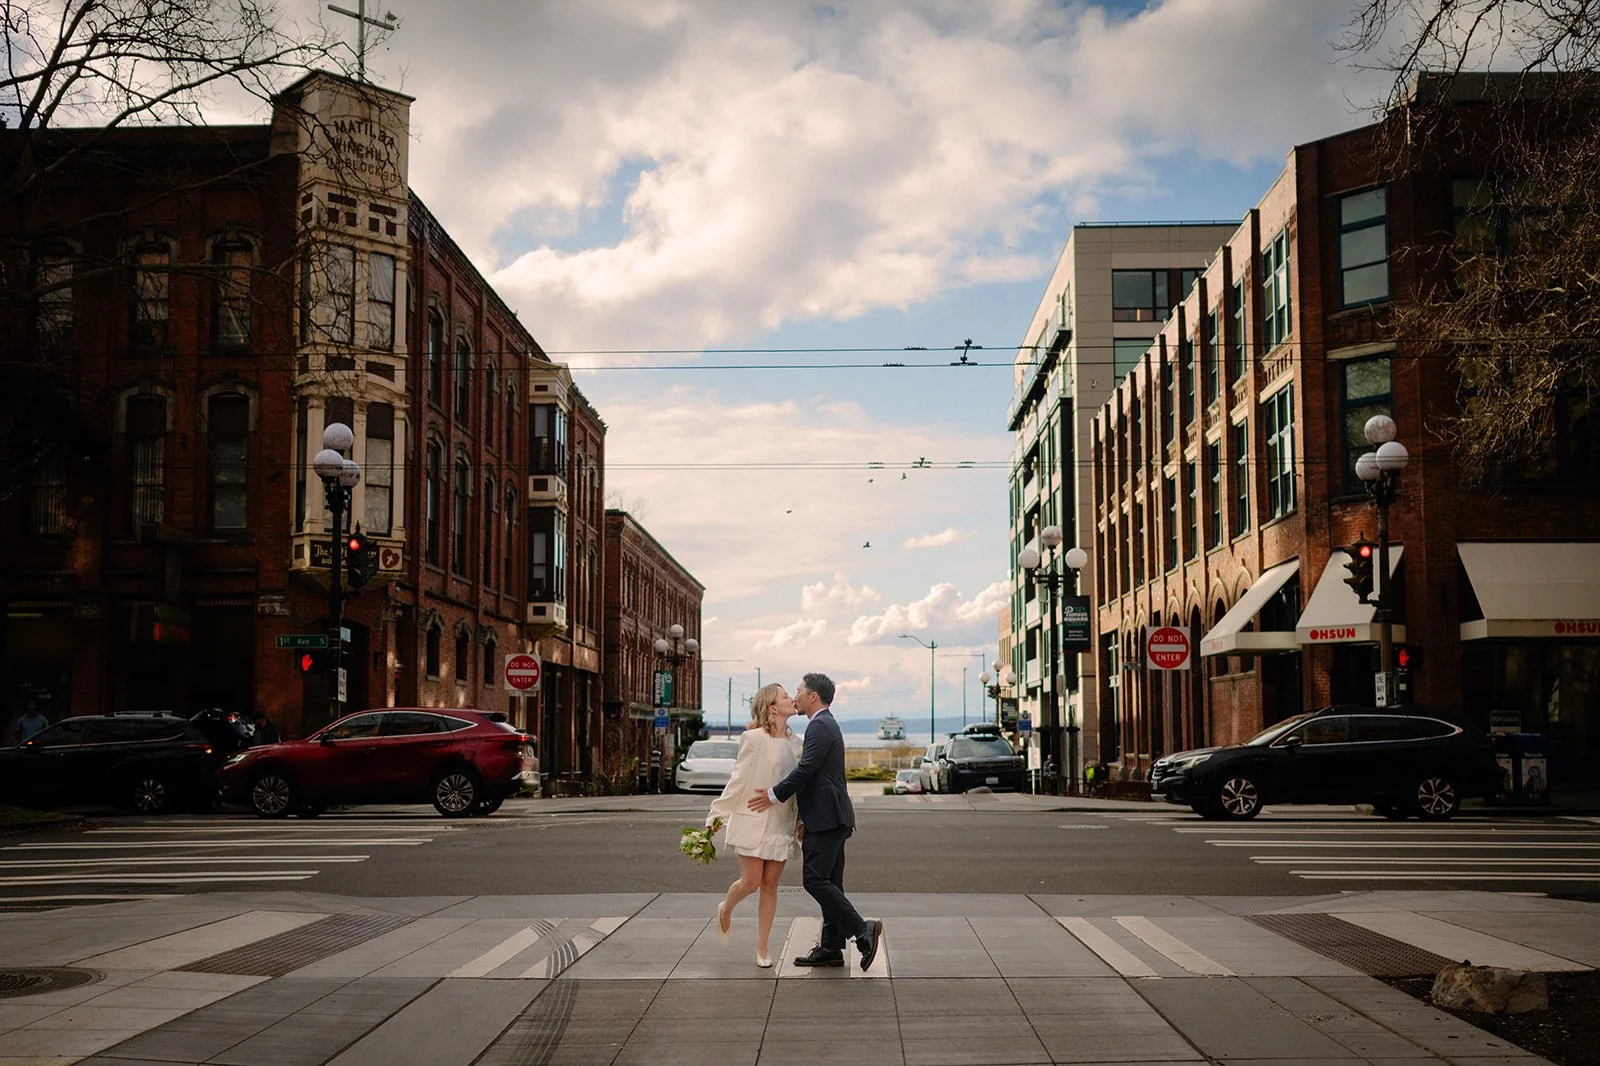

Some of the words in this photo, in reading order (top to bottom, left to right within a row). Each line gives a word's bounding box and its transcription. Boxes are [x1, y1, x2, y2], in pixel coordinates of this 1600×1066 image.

[334, 120, 395, 149] MATILDA
[1554, 622, 1600, 633] OHSU
[297, 637, 310, 645] Ave
[319, 637, 325, 645] S
[1156, 653, 1181, 661] ENTER
